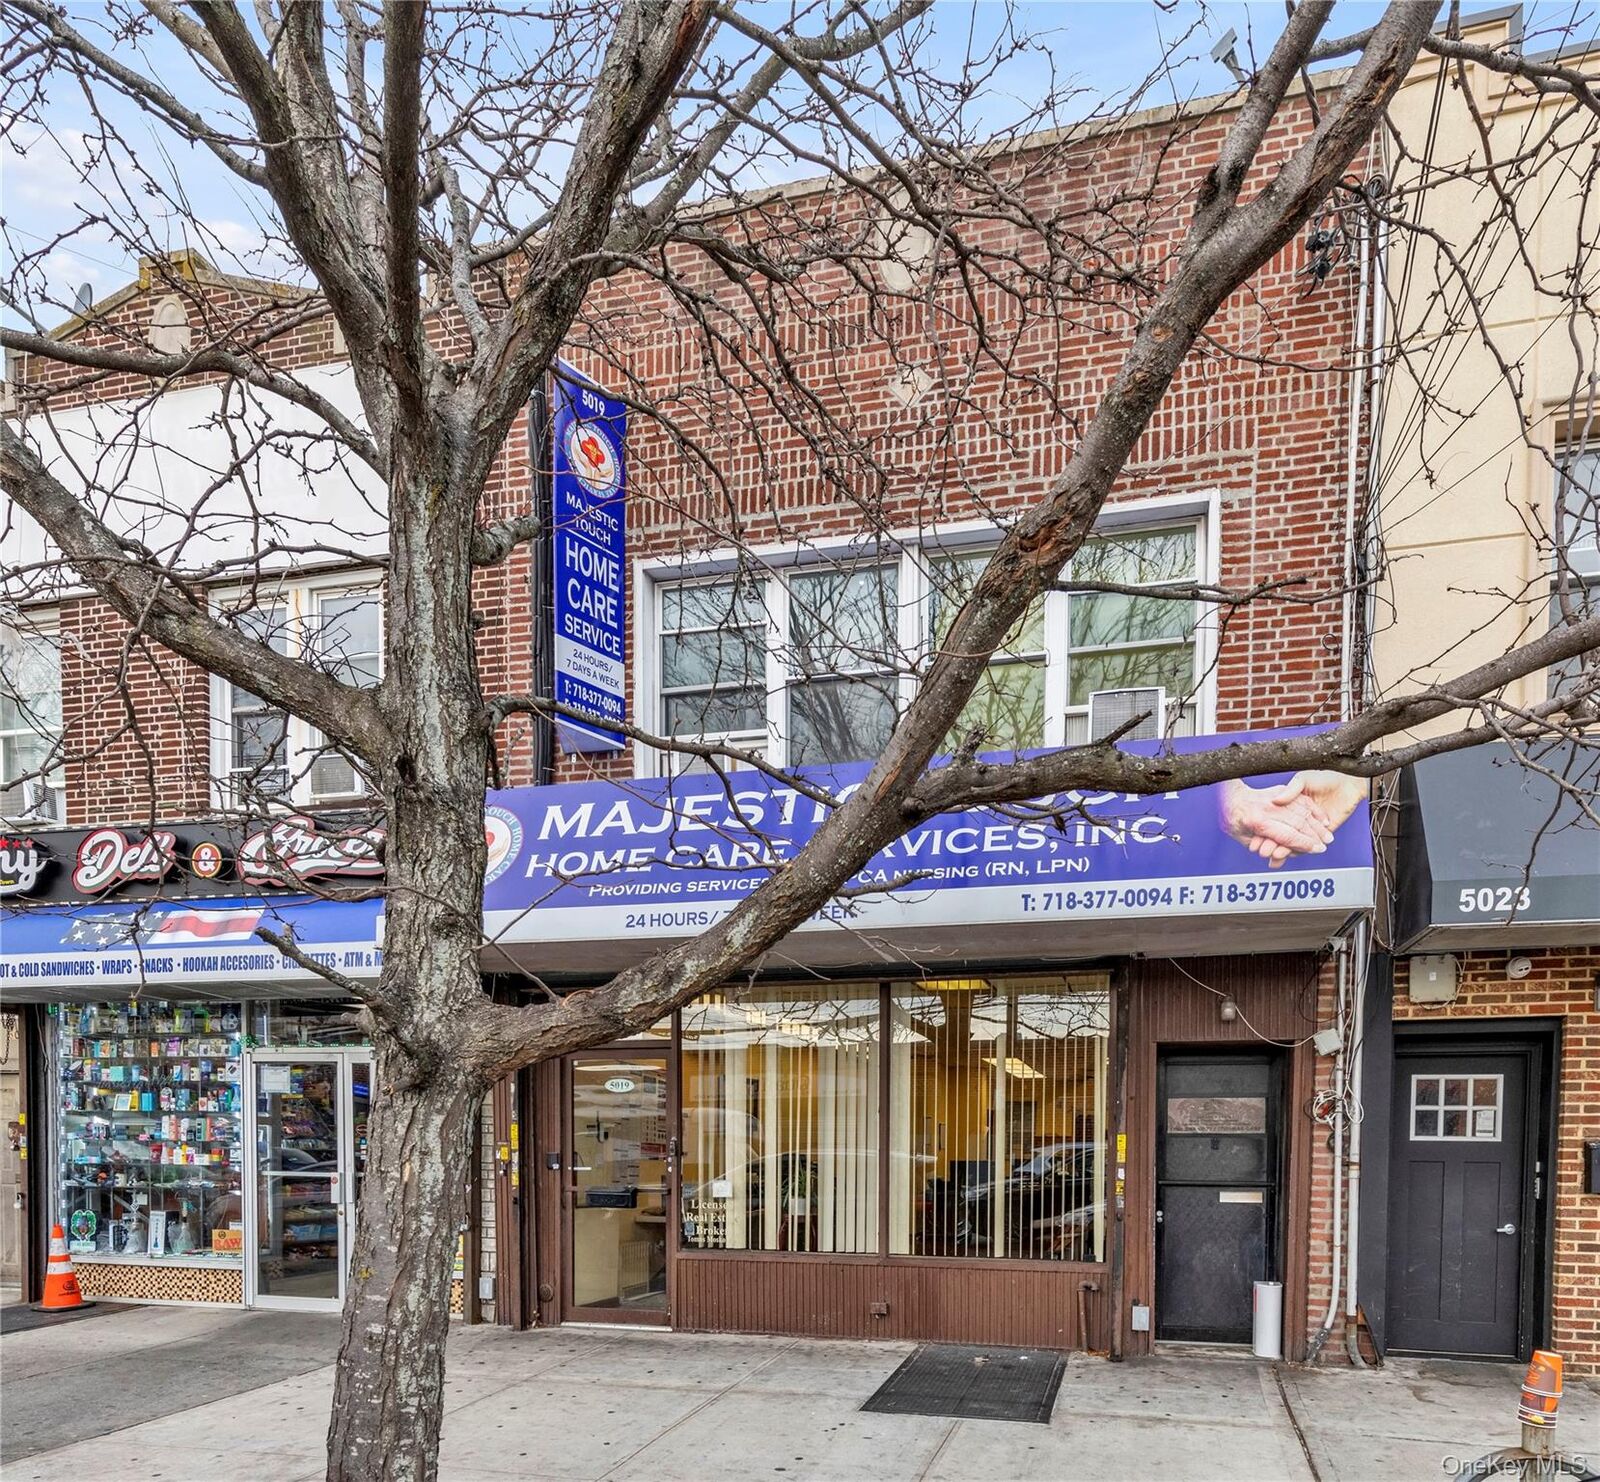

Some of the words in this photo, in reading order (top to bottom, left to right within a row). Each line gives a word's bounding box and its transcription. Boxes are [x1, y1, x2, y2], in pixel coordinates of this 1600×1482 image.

[582, 389, 605, 416] 5019
[566, 491, 618, 531] MAJESTIC
[573, 514, 611, 545] TOUCH
[566, 536, 619, 593] HOME
[567, 578, 618, 629] CARE
[565, 613, 620, 657] SERVICE
[573, 648, 583, 660] 24
[566, 658, 572, 667] 7
[573, 661, 592, 676] DAYS
[592, 671, 598, 680] A
[599, 673, 619, 689] WEEK
[564, 680, 572, 695] T:
[573, 683, 621, 715] 718-377-0094
[525, 847, 656, 878] HOME
[665, 838, 793, 871] CARE
[1075, 817, 1180, 848] INC.
[589, 882, 682, 897] PROVIDING
[985, 861, 1029, 877] (RN,
[1036, 857, 1090, 874] LPN)
[1021, 893, 1036, 911] T:
[1043, 887, 1172, 911] 718-377-0094
[1179, 886, 1195, 905] F:
[1202, 878, 1335, 904] 718-3770098
[1459, 886, 1531, 912] 5023
[625, 914, 645, 928] 24
[11, 966, 17, 977] &
[19, 962, 39, 977] COLD
[41, 960, 95, 977] SANDWICHES
[102, 959, 132, 975] WRAPS
[183, 956, 218, 972] HOOKAH
[220, 954, 275, 971] ACCESORIES
[344, 951, 363, 967] ATM
[365, 954, 372, 966] &
[610, 1081, 630, 1090] 5019
